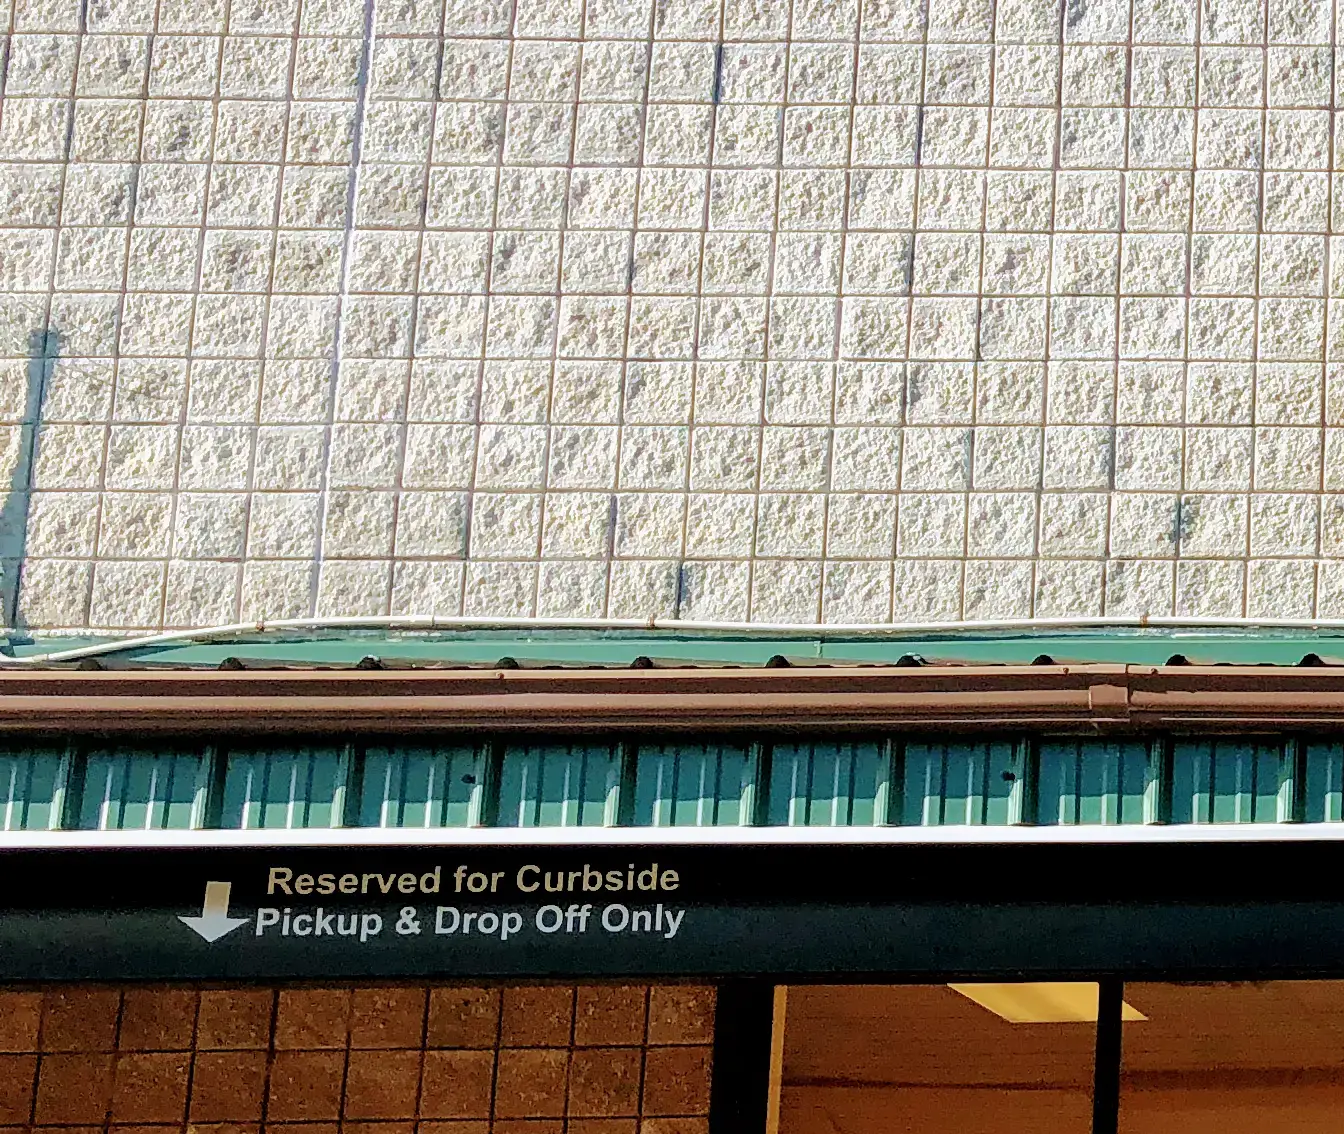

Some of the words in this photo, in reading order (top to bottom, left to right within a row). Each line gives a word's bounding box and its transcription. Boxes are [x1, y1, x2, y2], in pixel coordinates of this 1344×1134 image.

[266, 866, 442, 895] Reserved
[453, 865, 502, 893] for
[516, 863, 681, 893] Curbside
[255, 907, 383, 943] Pickup
[395, 906, 422, 935] &
[435, 906, 523, 939] Drop
[535, 904, 592, 933] Off
[600, 903, 686, 939] Only
